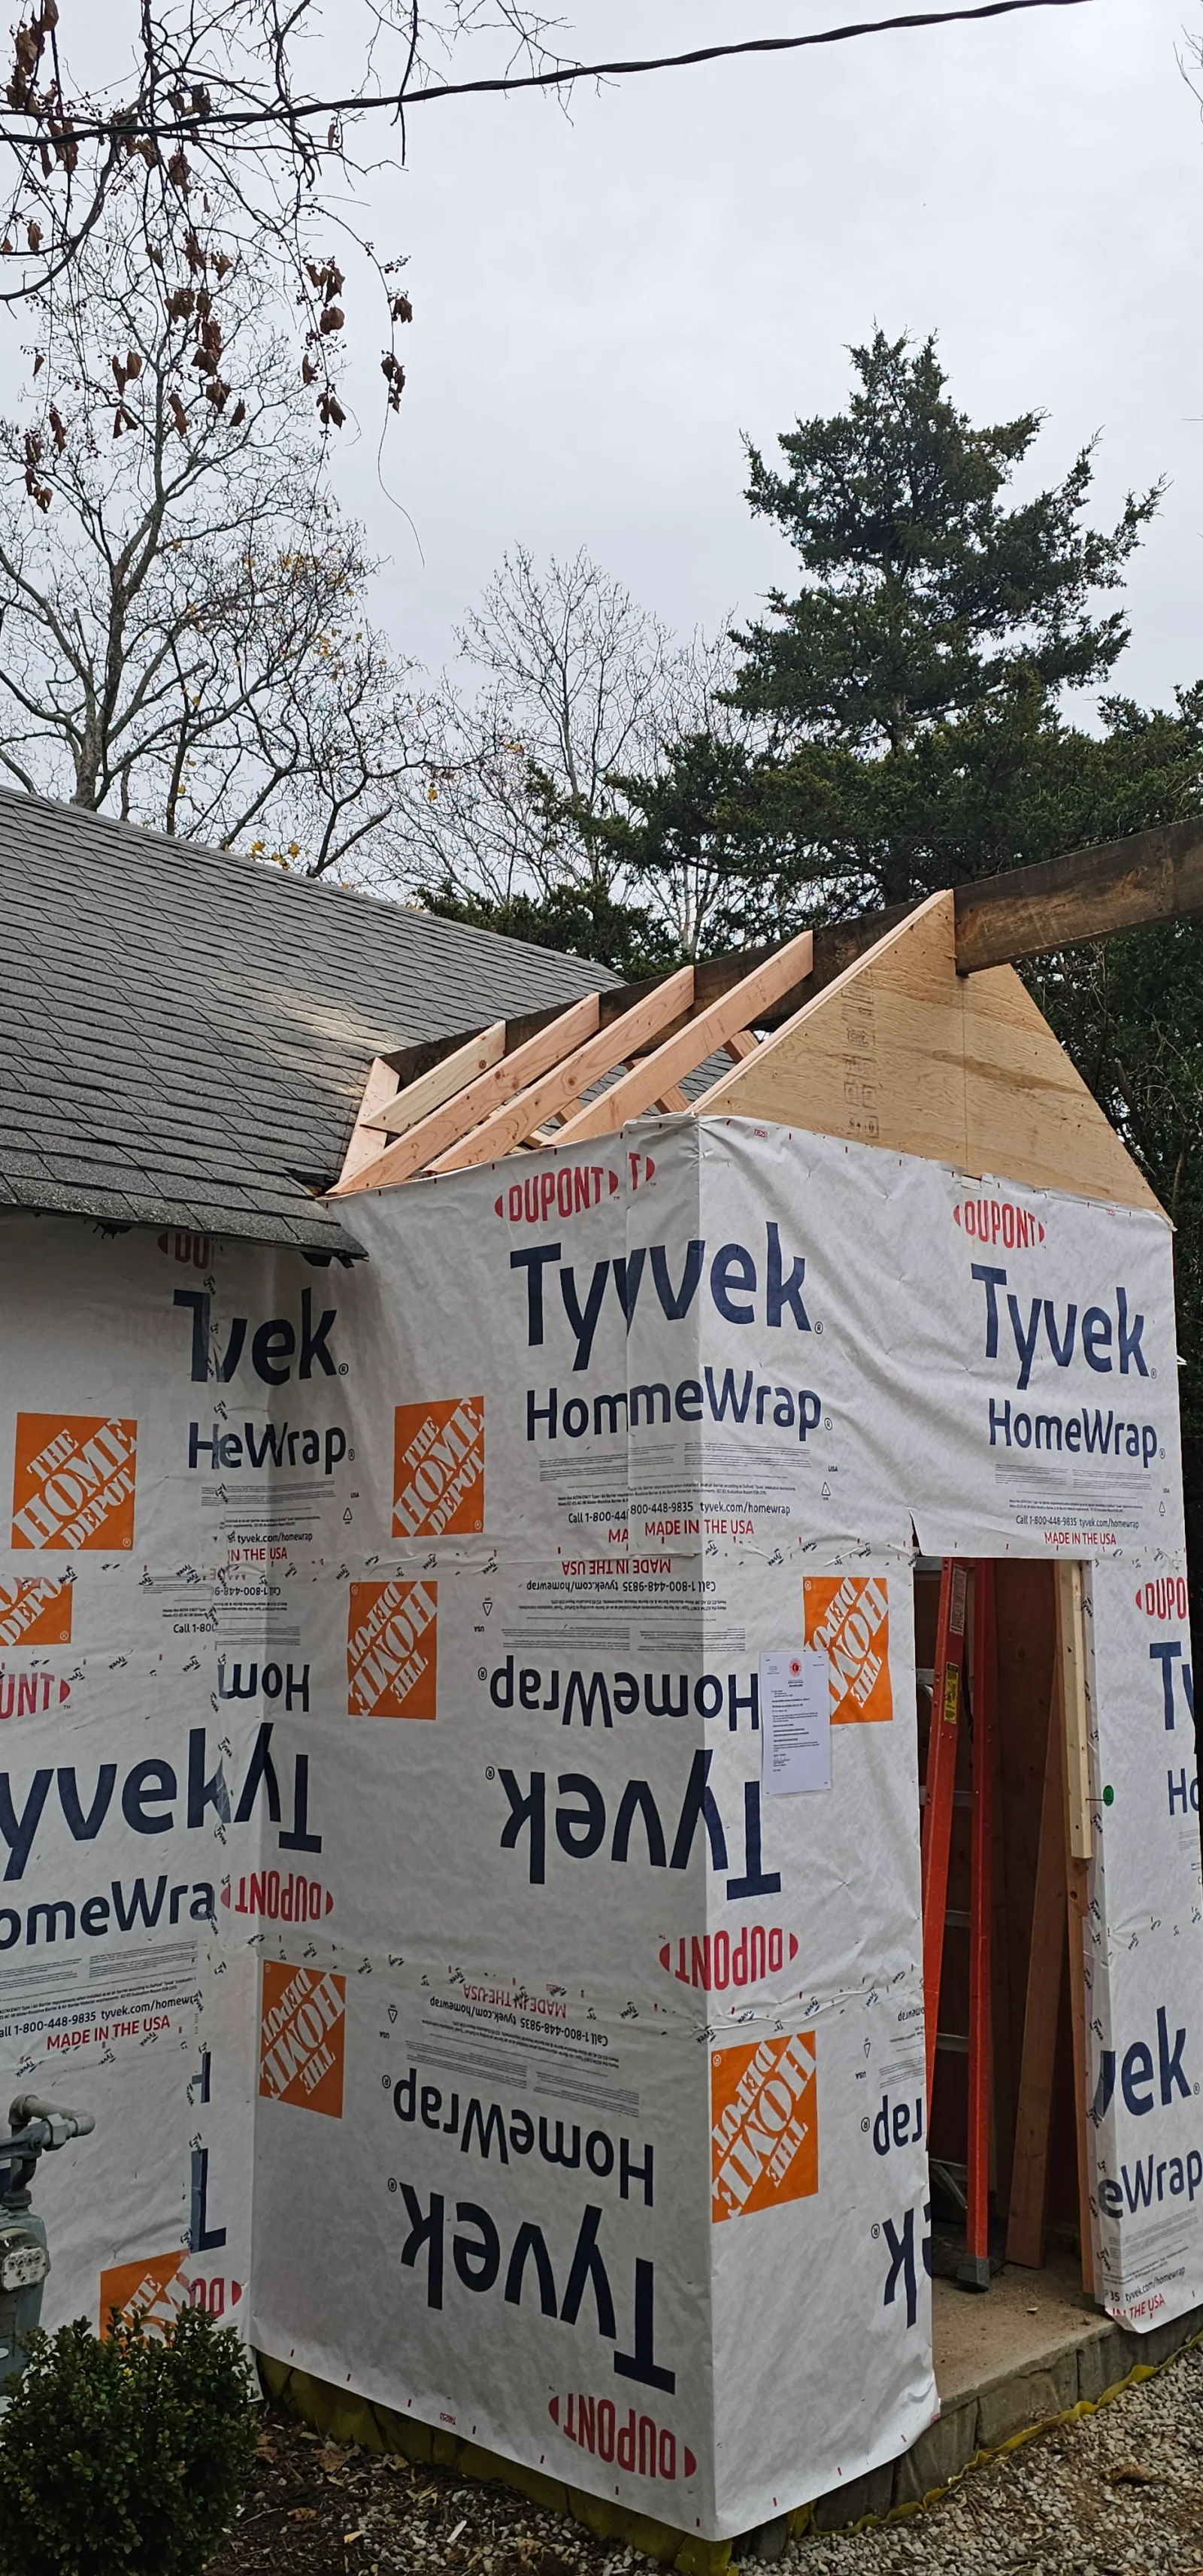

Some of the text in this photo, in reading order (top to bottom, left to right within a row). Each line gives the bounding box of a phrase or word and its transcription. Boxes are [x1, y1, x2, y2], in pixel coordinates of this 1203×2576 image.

[509, 1165, 604, 1223] DUPONT
[965, 1200, 1036, 1248] DUPONT
[26, 1429, 79, 1482] THE
[392, 1396, 485, 1537] HOME
[402, 1416, 440, 1471] THE
[13, 1418, 137, 1550] HOME
[60, 1467, 135, 1550] DEPOT
[427, 1445, 485, 1535] DEPOT
[700, 1502, 790, 1516] tyvek.com/homewrap
[237, 1532, 313, 1544] tyvek.com/homewrap
[568, 1513, 583, 1523] Call
[645, 1520, 754, 1536] MADE IN THE USA
[1016, 1514, 1139, 1529] Call 1-800-448-9835 tyvek.com/homewrap
[1044, 1532, 1117, 1545] MADE IN THE USA
[243, 1548, 265, 1561] THE
[269, 1547, 288, 1560] USA
[561, 1558, 671, 1575] MADE IN THE USA
[0, 1577, 63, 1647] DEPO
[269, 1587, 281, 1596] Call
[526, 1580, 717, 1593] Call 1-800-448-9835 tyvek.com/homewrap
[1145, 1577, 1187, 1620] DUPO
[173, 1623, 190, 1633] Call
[347, 1581, 402, 1665] DEPOT
[804, 1577, 857, 1651] DEPO
[348, 1580, 438, 1717] HOME
[390, 1650, 429, 1704] THE
[850, 1649, 883, 1708] THE
[497, 1749, 781, 1901] Tyvek
[235, 1871, 322, 1923] DUPONT
[675, 1925, 783, 1992] DUPONT
[14, 2011, 96, 2035] 1-800-448-9835
[262, 1967, 313, 2047] DEPOT
[430, 1996, 517, 2026] tyvek.com/homewrap
[489, 1988, 511, 2007] THE
[530, 1996, 566, 2019] MADE
[47, 2015, 171, 2051] MADE IN THE USA
[260, 1972, 345, 2101] HOME
[520, 2017, 589, 2042] 1-800-448-9835
[592, 2033, 608, 2047] Call
[299, 2042, 336, 2095] THE
[711, 2039, 777, 2157] DEPOT
[393, 2068, 654, 2208] HomeWrap
[712, 2034, 817, 2220] HOME
[765, 2115, 809, 2188] THE
[399, 2182, 676, 2396] Tyvek
[1125, 2266, 1186, 2303] tyvek.com/homewrap
[1129, 2301, 1146, 2320] THE
[1147, 2293, 1166, 2312] USA
[562, 2393, 676, 2481] DUPONT
